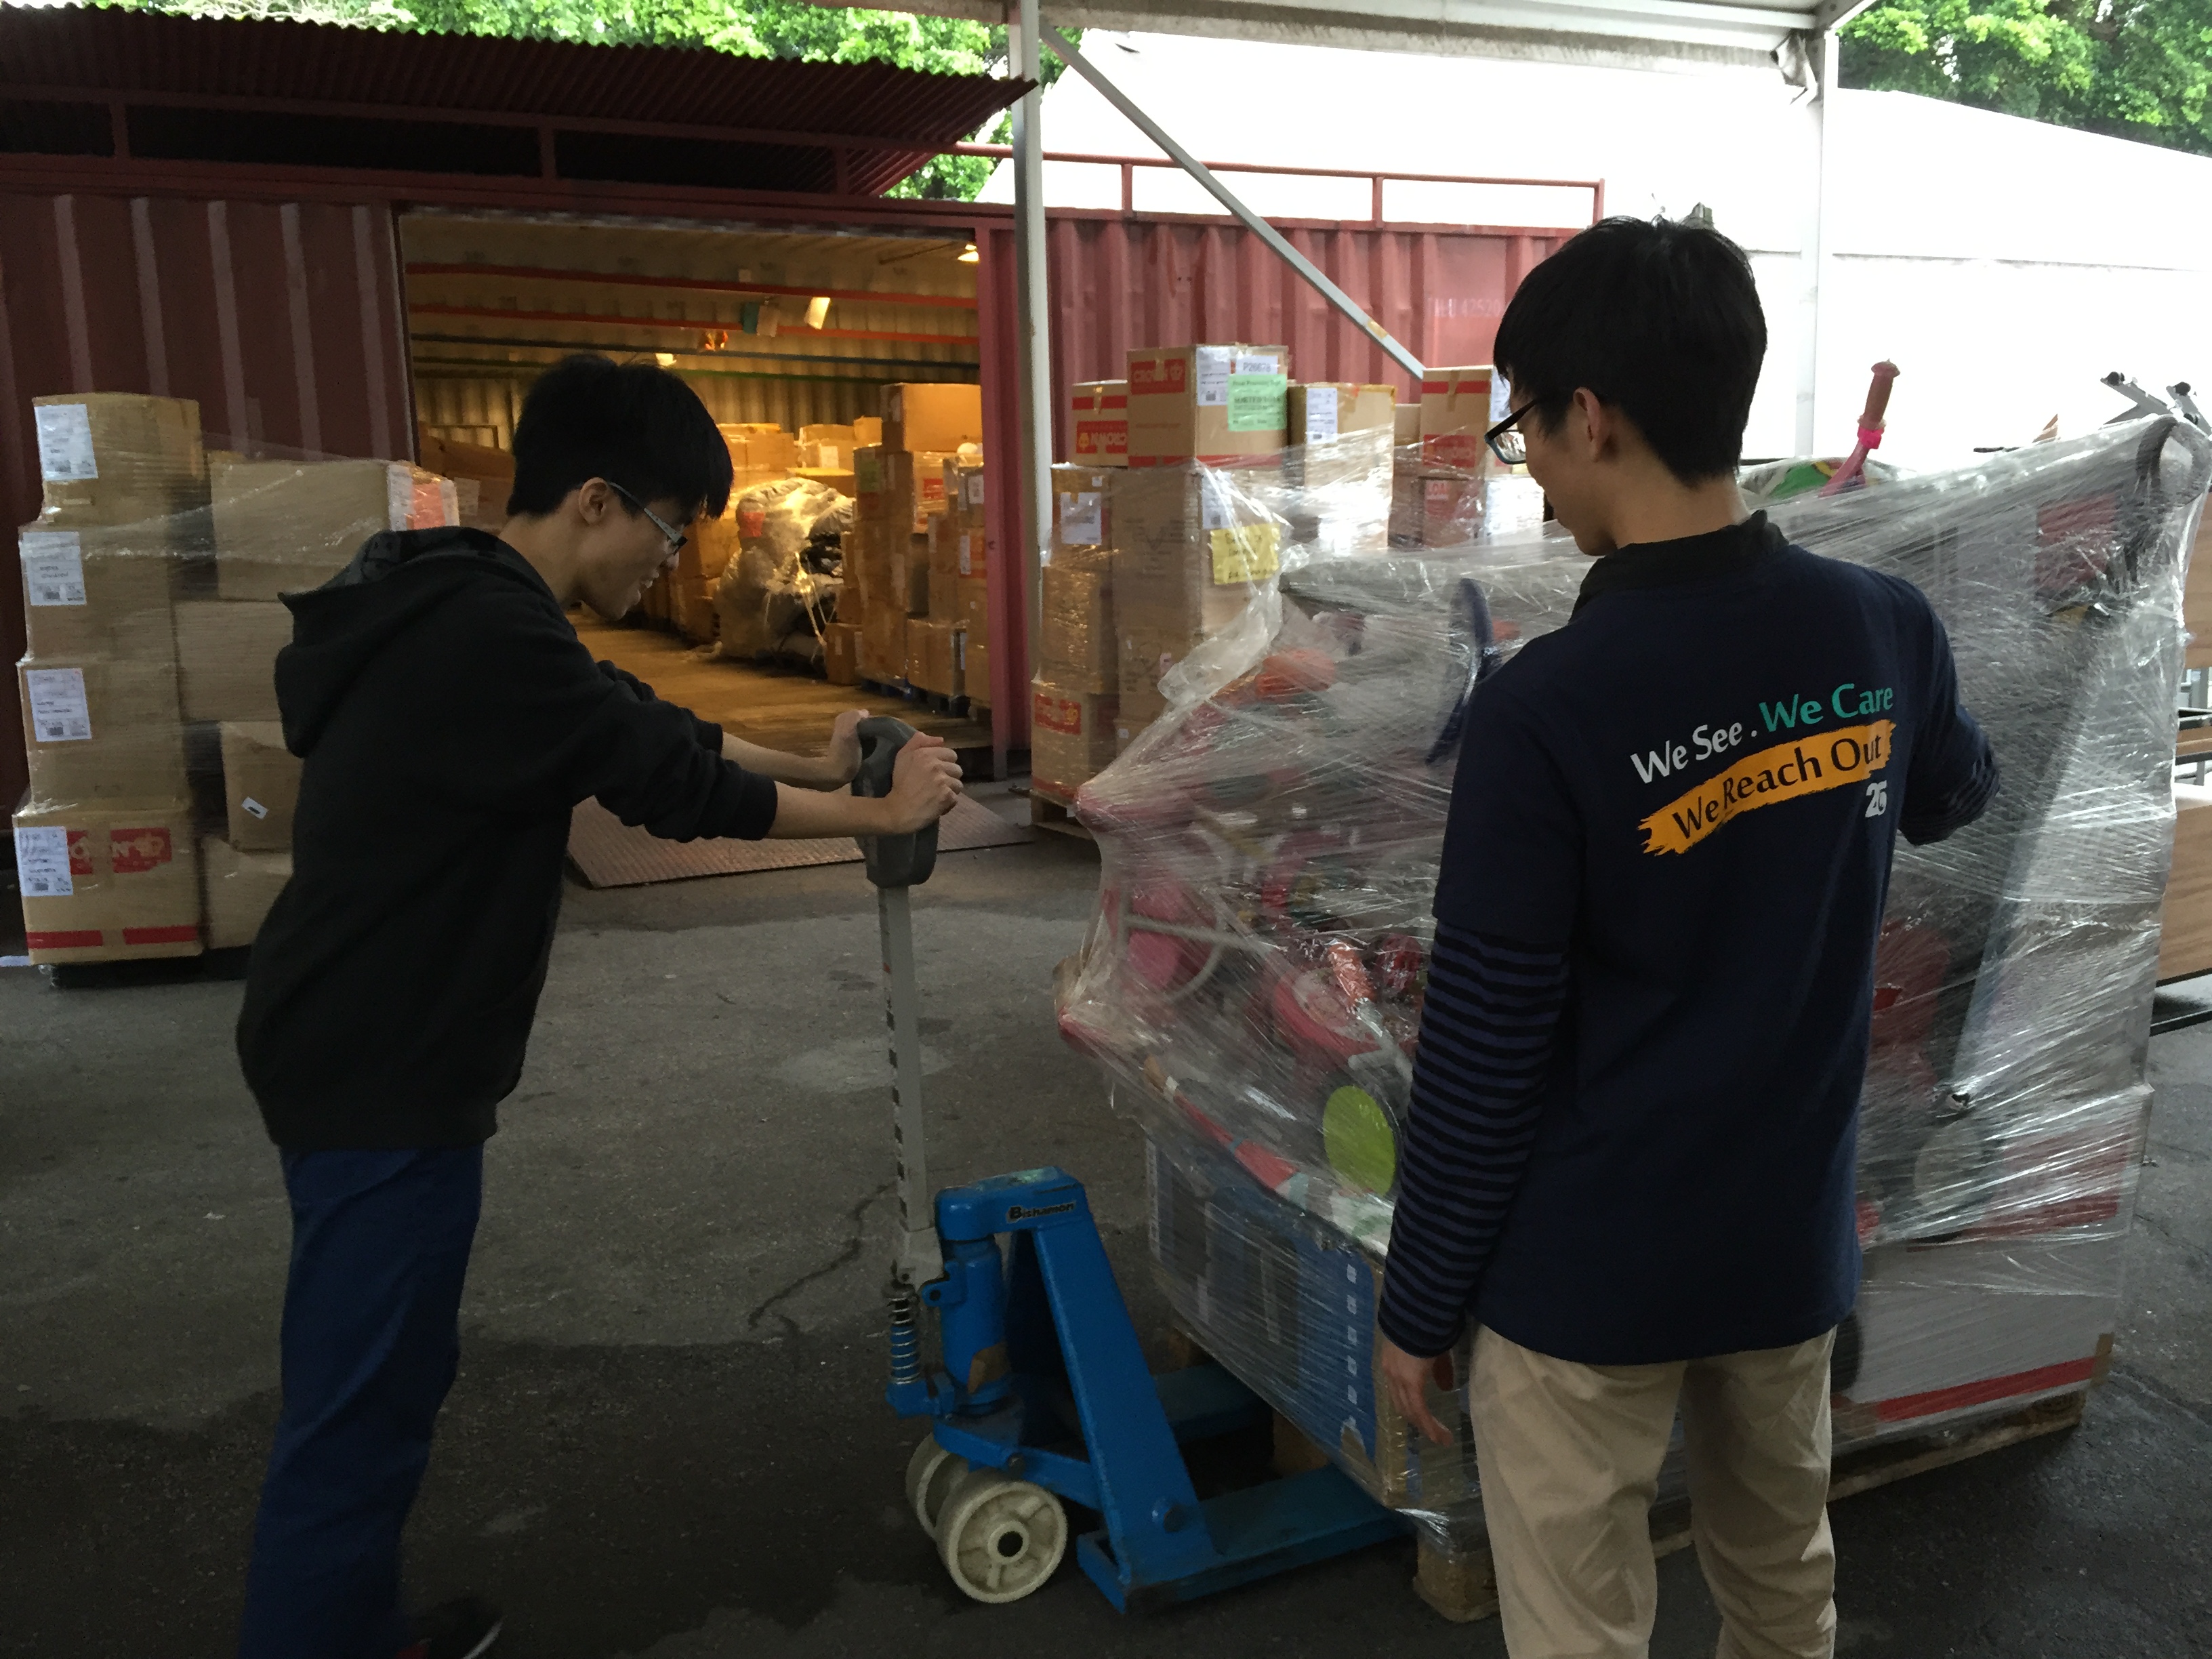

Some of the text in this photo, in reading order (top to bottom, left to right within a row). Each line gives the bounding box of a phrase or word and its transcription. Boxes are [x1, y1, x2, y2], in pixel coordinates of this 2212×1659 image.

[1630, 739, 1689, 784] We
[1759, 693, 1824, 733] We
[1831, 682, 1894, 720] Care
[1671, 734, 1882, 841] We Reach Out
[1010, 1202, 1073, 1220] Bishamon
